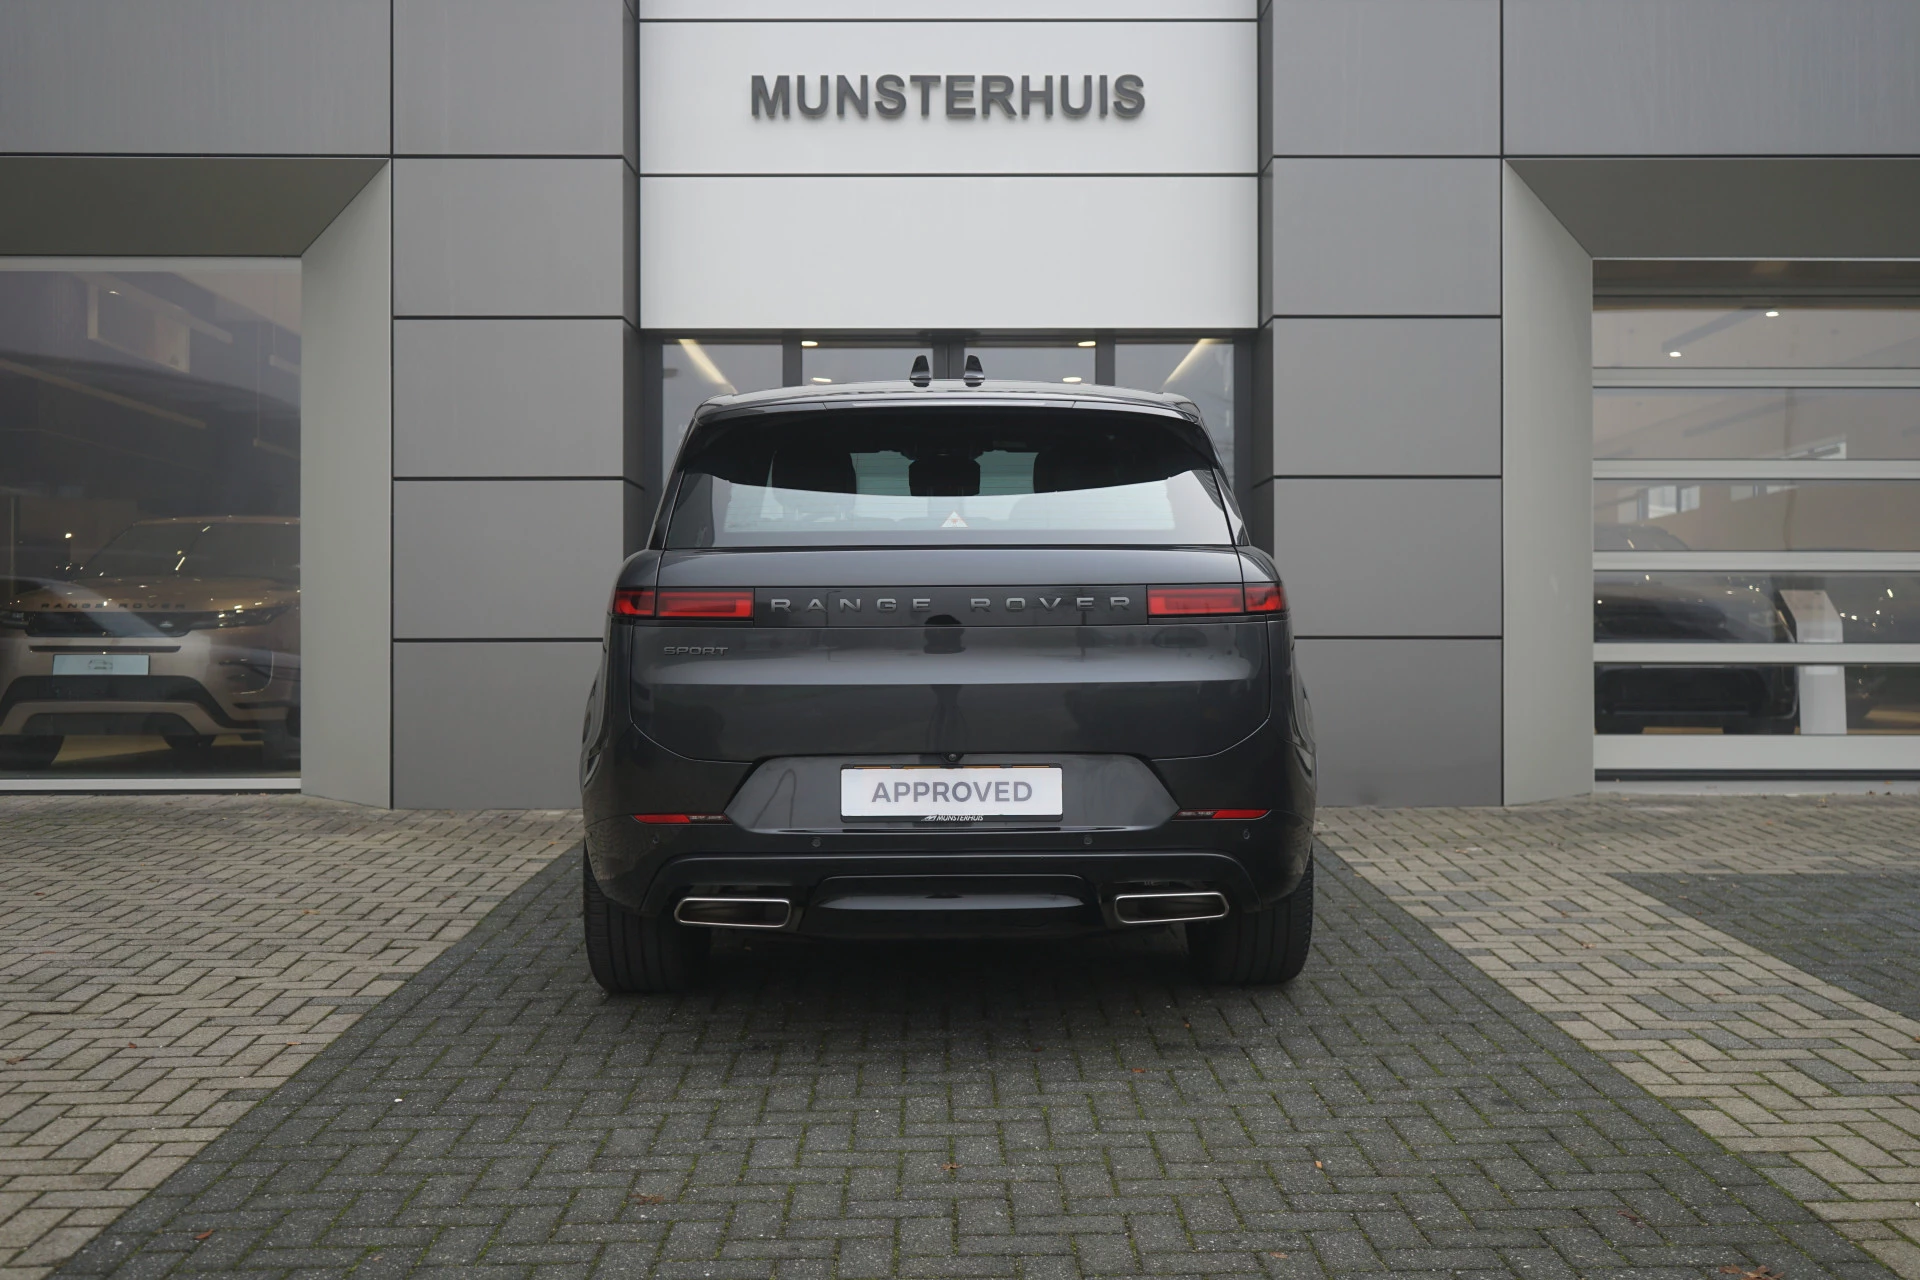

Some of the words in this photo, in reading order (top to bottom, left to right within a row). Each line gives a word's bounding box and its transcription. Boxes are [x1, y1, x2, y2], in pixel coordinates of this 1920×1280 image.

[751, 74, 1146, 117] MUNSTERHUIS
[770, 598, 932, 613] RANGE
[970, 596, 1130, 612] ROVER
[663, 646, 729, 656] SPORT
[871, 781, 1033, 803] APPROVED
